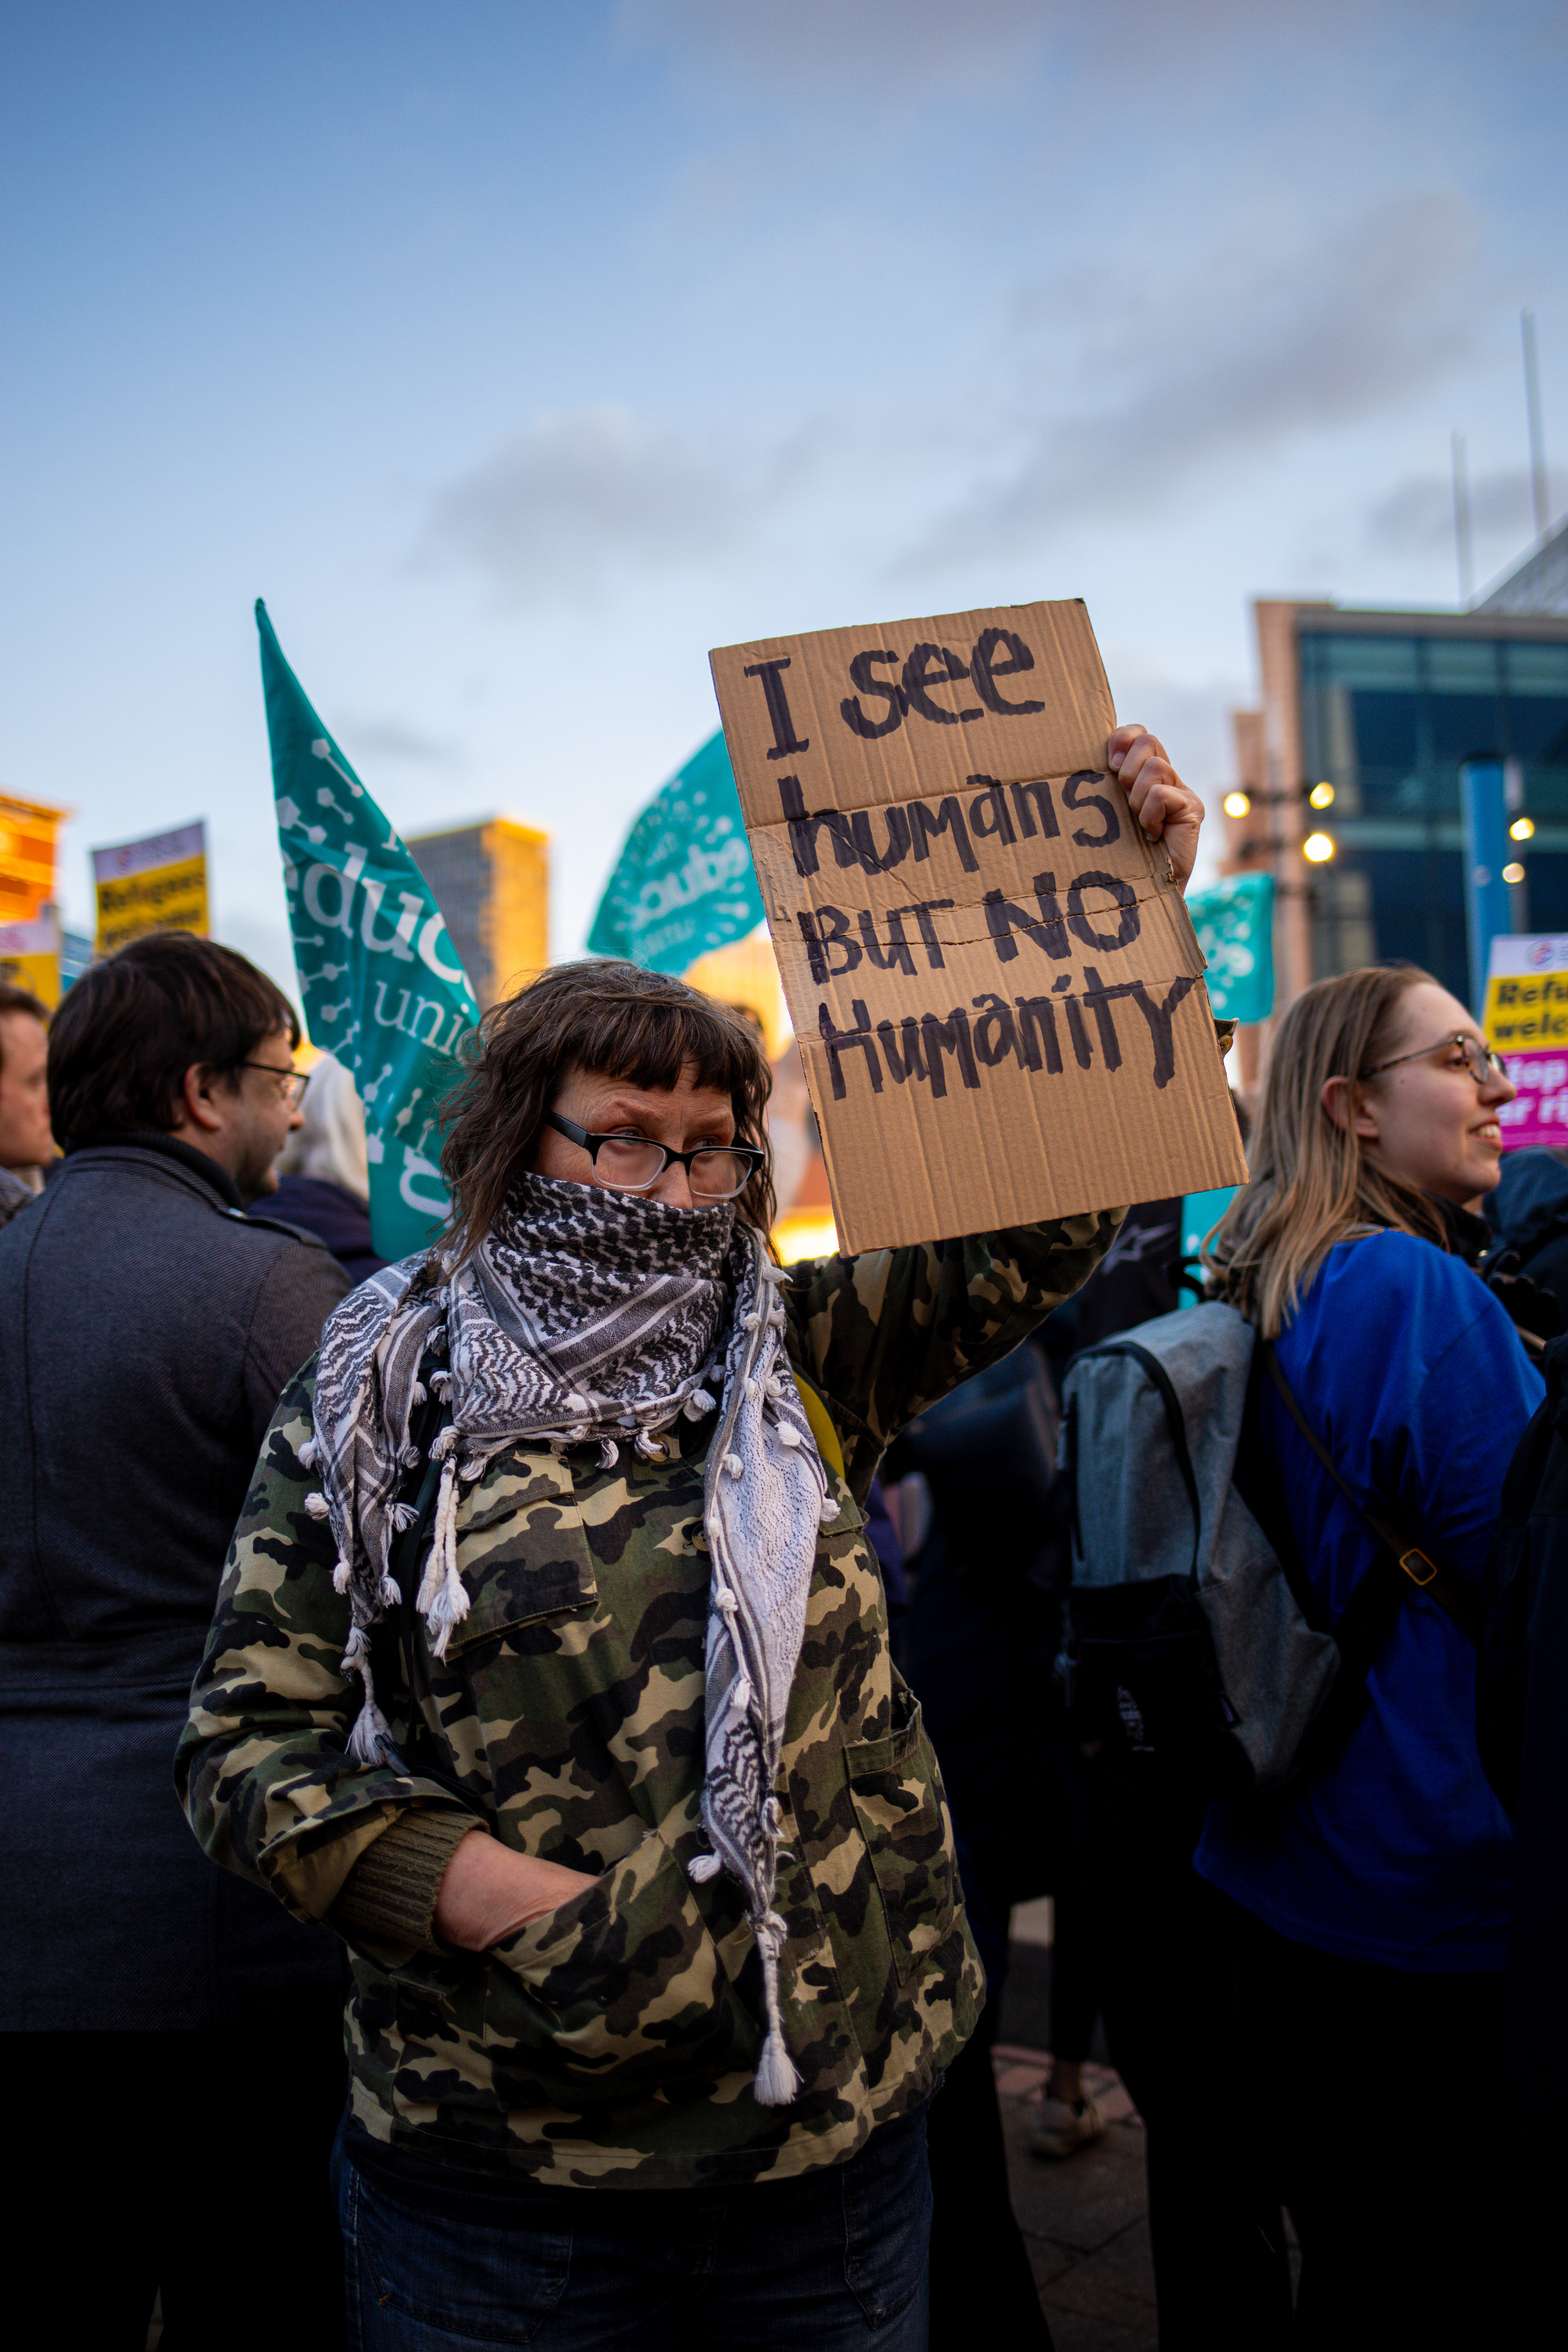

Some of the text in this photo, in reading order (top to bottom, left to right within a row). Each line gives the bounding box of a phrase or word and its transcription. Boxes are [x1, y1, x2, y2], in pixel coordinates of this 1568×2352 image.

[743, 657, 810, 761] I
[282, 842, 477, 1002] duc
[798, 898, 956, 985] BUT
[982, 870, 1141, 963] NO
[1506, 1057, 1567, 1094] top
